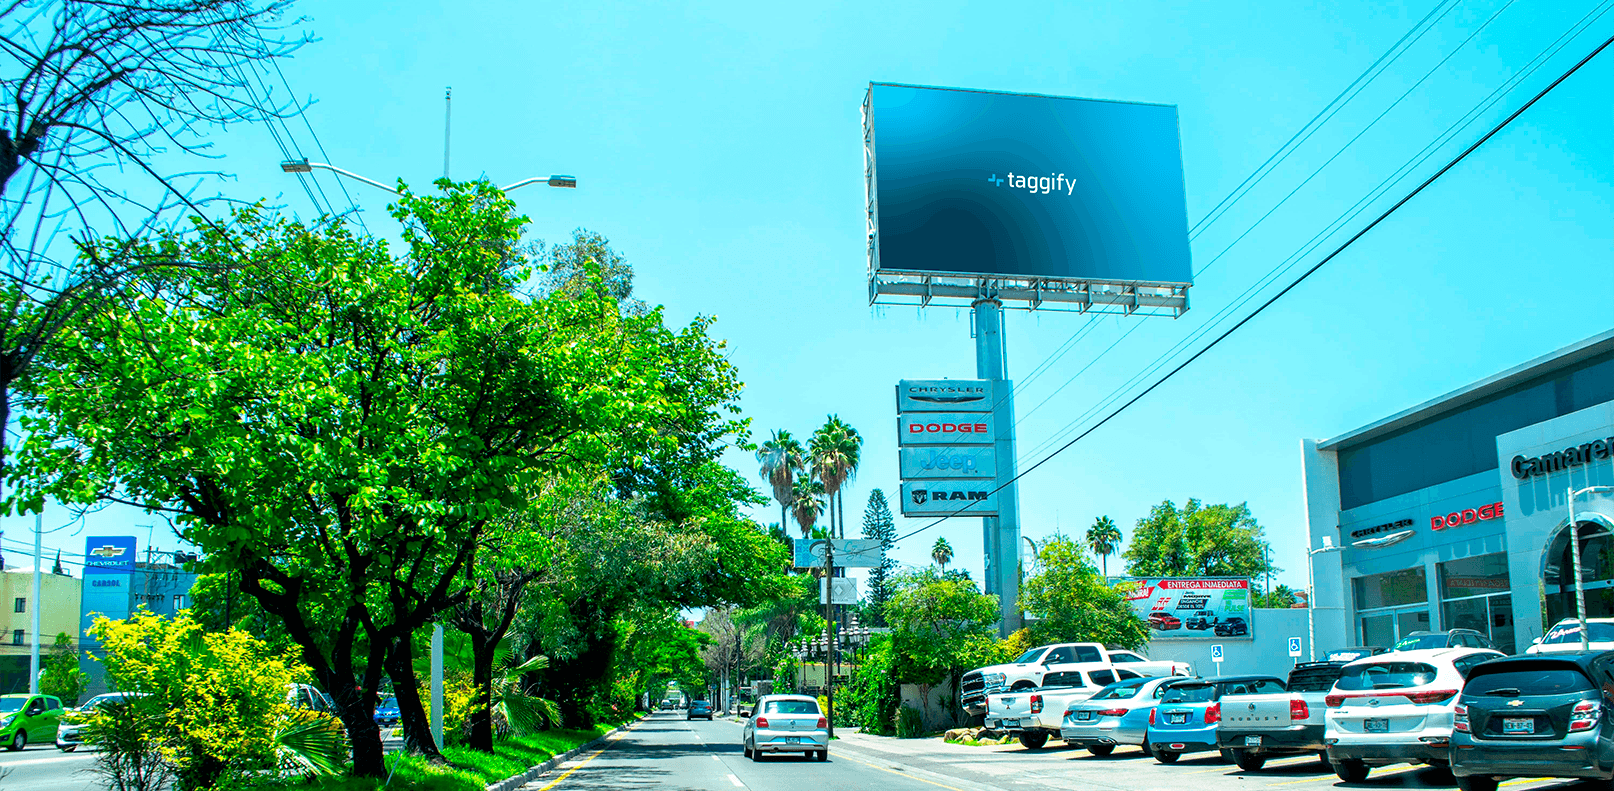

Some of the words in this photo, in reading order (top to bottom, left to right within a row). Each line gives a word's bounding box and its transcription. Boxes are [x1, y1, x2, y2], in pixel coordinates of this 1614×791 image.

[1007, 172, 1077, 196] taggify
[909, 423, 988, 433] DODGE
[921, 450, 976, 474] Jeep
[932, 491, 988, 501] RAM
[1430, 501, 1504, 531] DODGE
[1351, 518, 1414, 538] CHRYSLER
